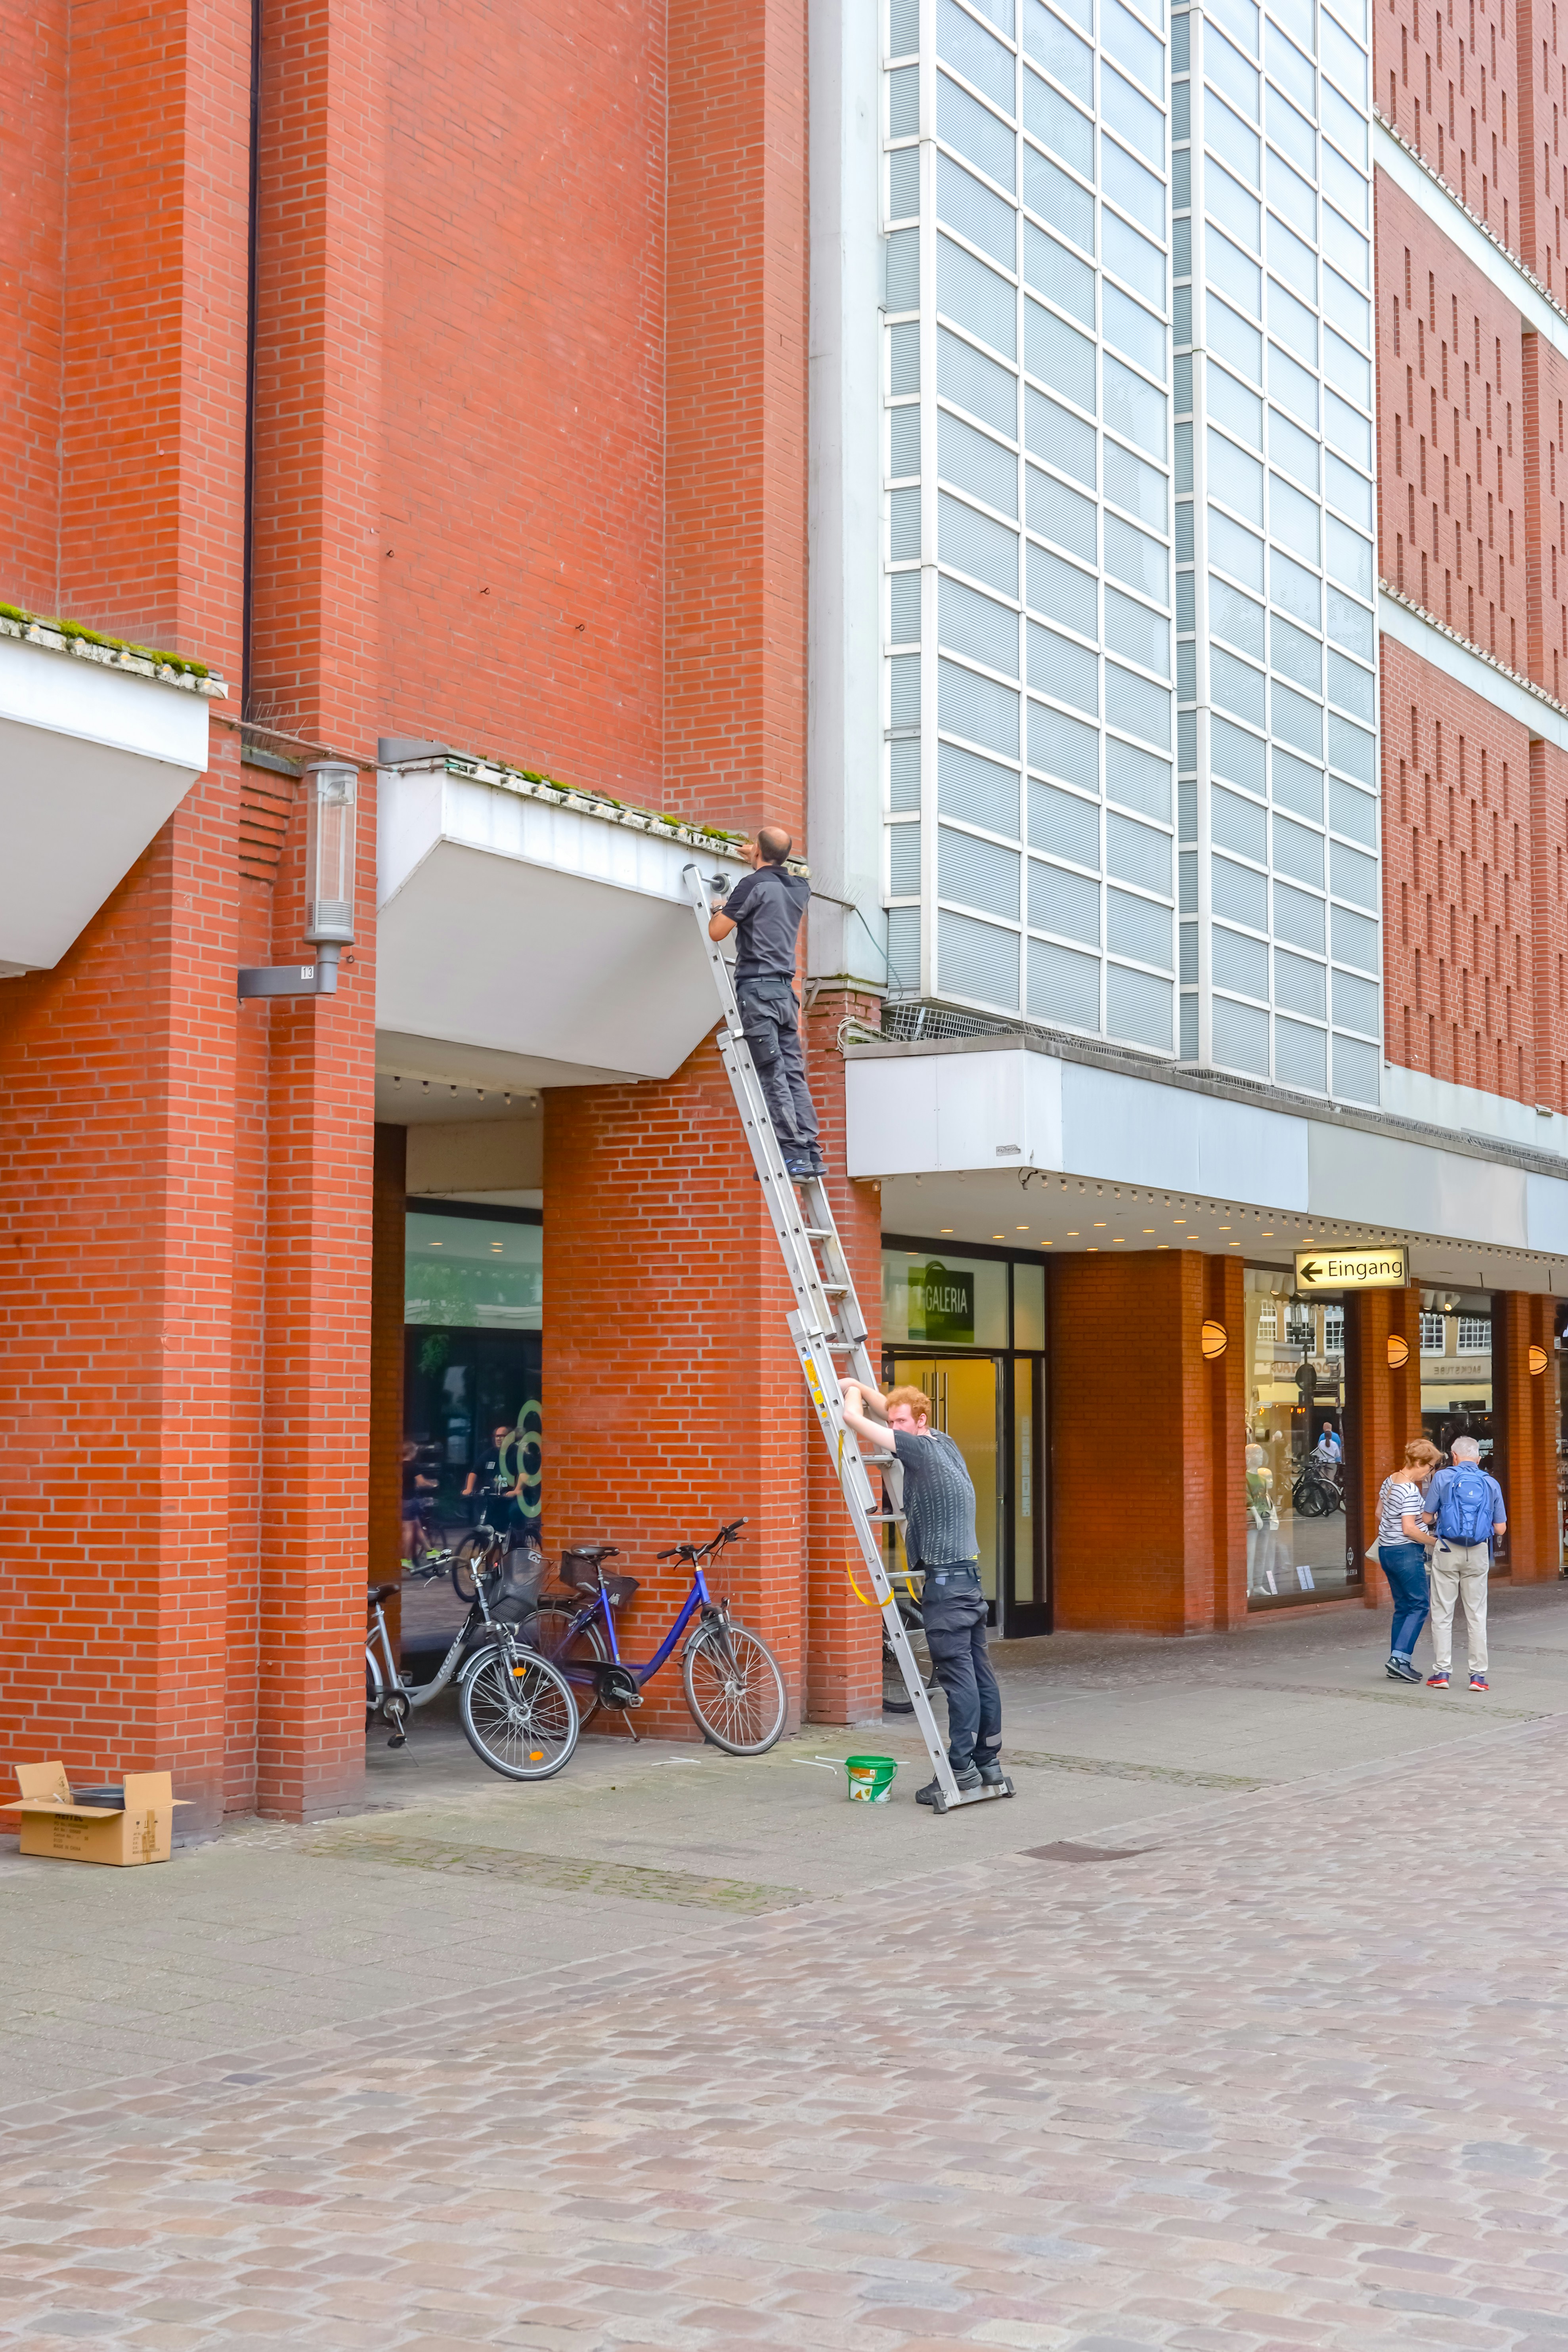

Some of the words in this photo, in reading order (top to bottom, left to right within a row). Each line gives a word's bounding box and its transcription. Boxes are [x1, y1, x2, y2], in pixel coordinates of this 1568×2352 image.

[304, 968, 312, 977] 13
[1329, 1261, 1402, 1279] Eingang
[926, 1285, 968, 1314] GALERIA
